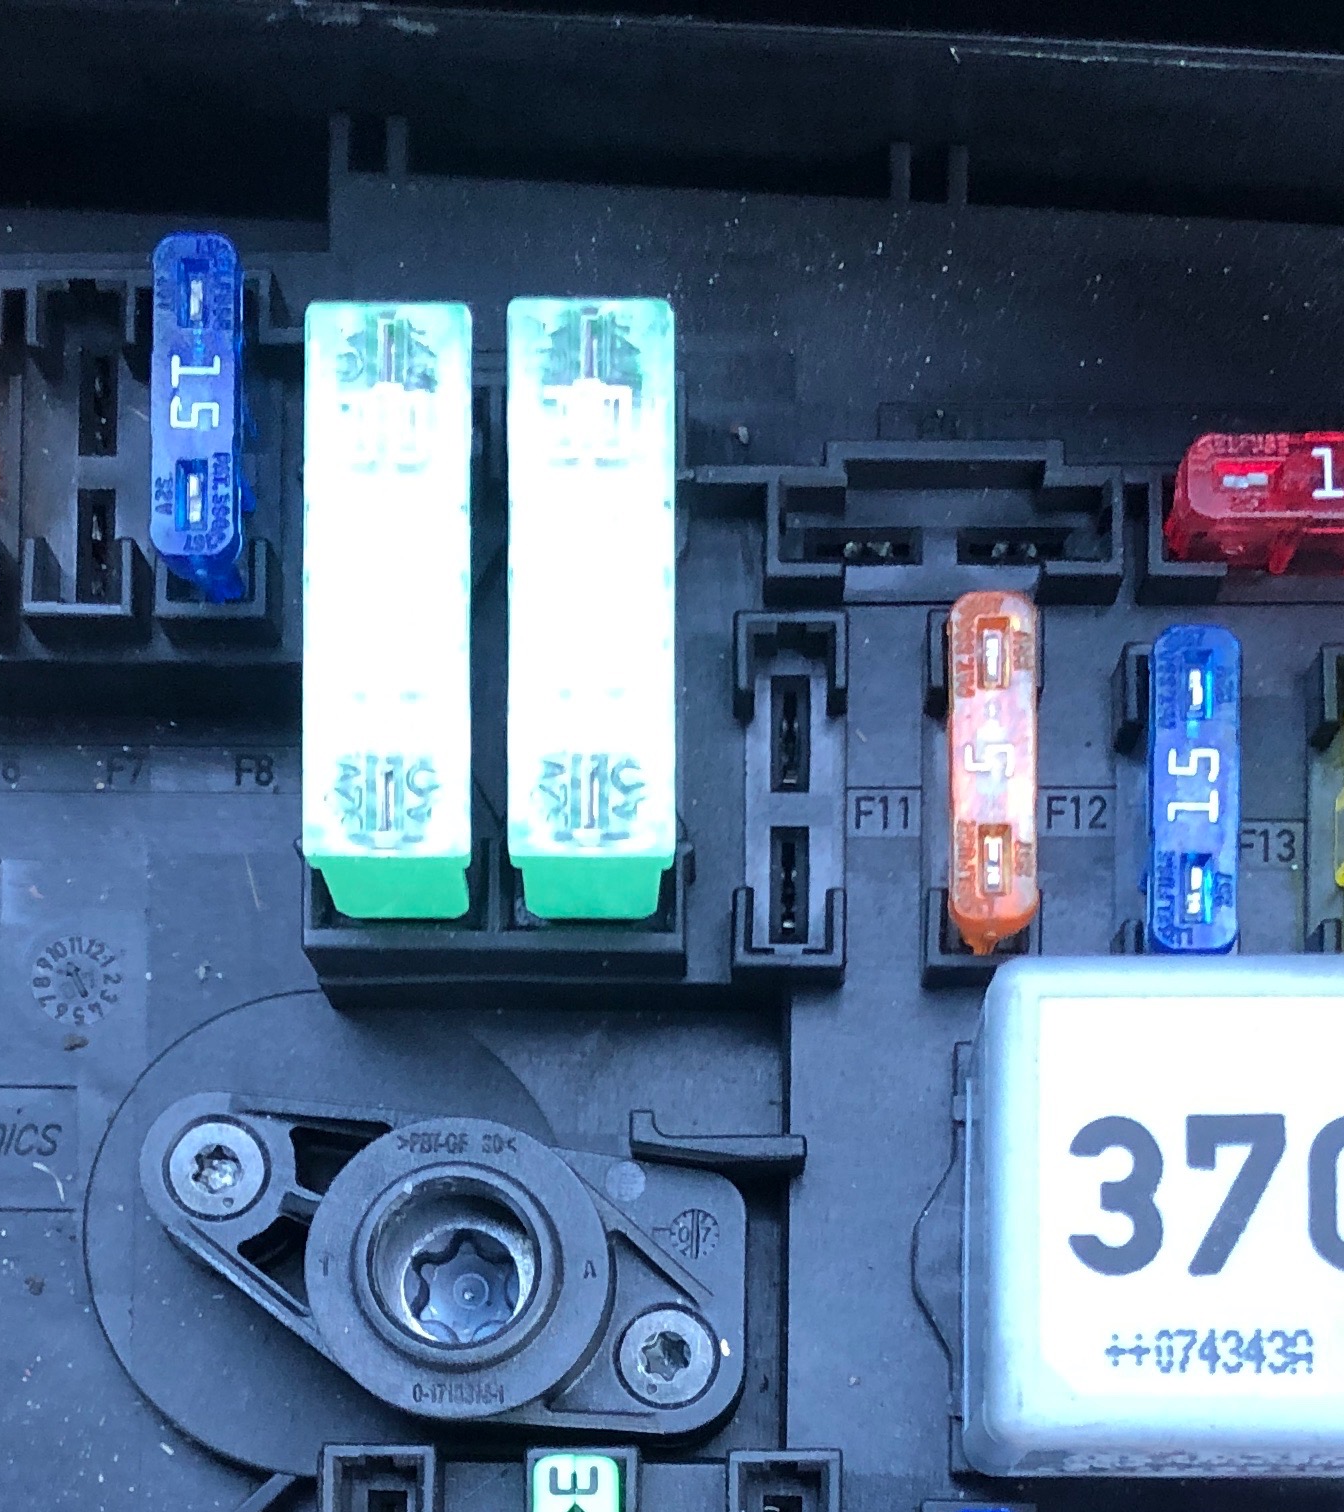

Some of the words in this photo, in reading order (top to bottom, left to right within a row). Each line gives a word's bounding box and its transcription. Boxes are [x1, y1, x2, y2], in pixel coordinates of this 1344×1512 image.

[170, 355, 221, 430] 15
[106, 757, 145, 786] F7
[234, 756, 275, 787] F8
[963, 742, 1017, 778] 5
[1167, 748, 1220, 823] 15
[854, 795, 911, 831] F11
[1046, 794, 1108, 830] F12
[1241, 828, 1296, 864] F13
